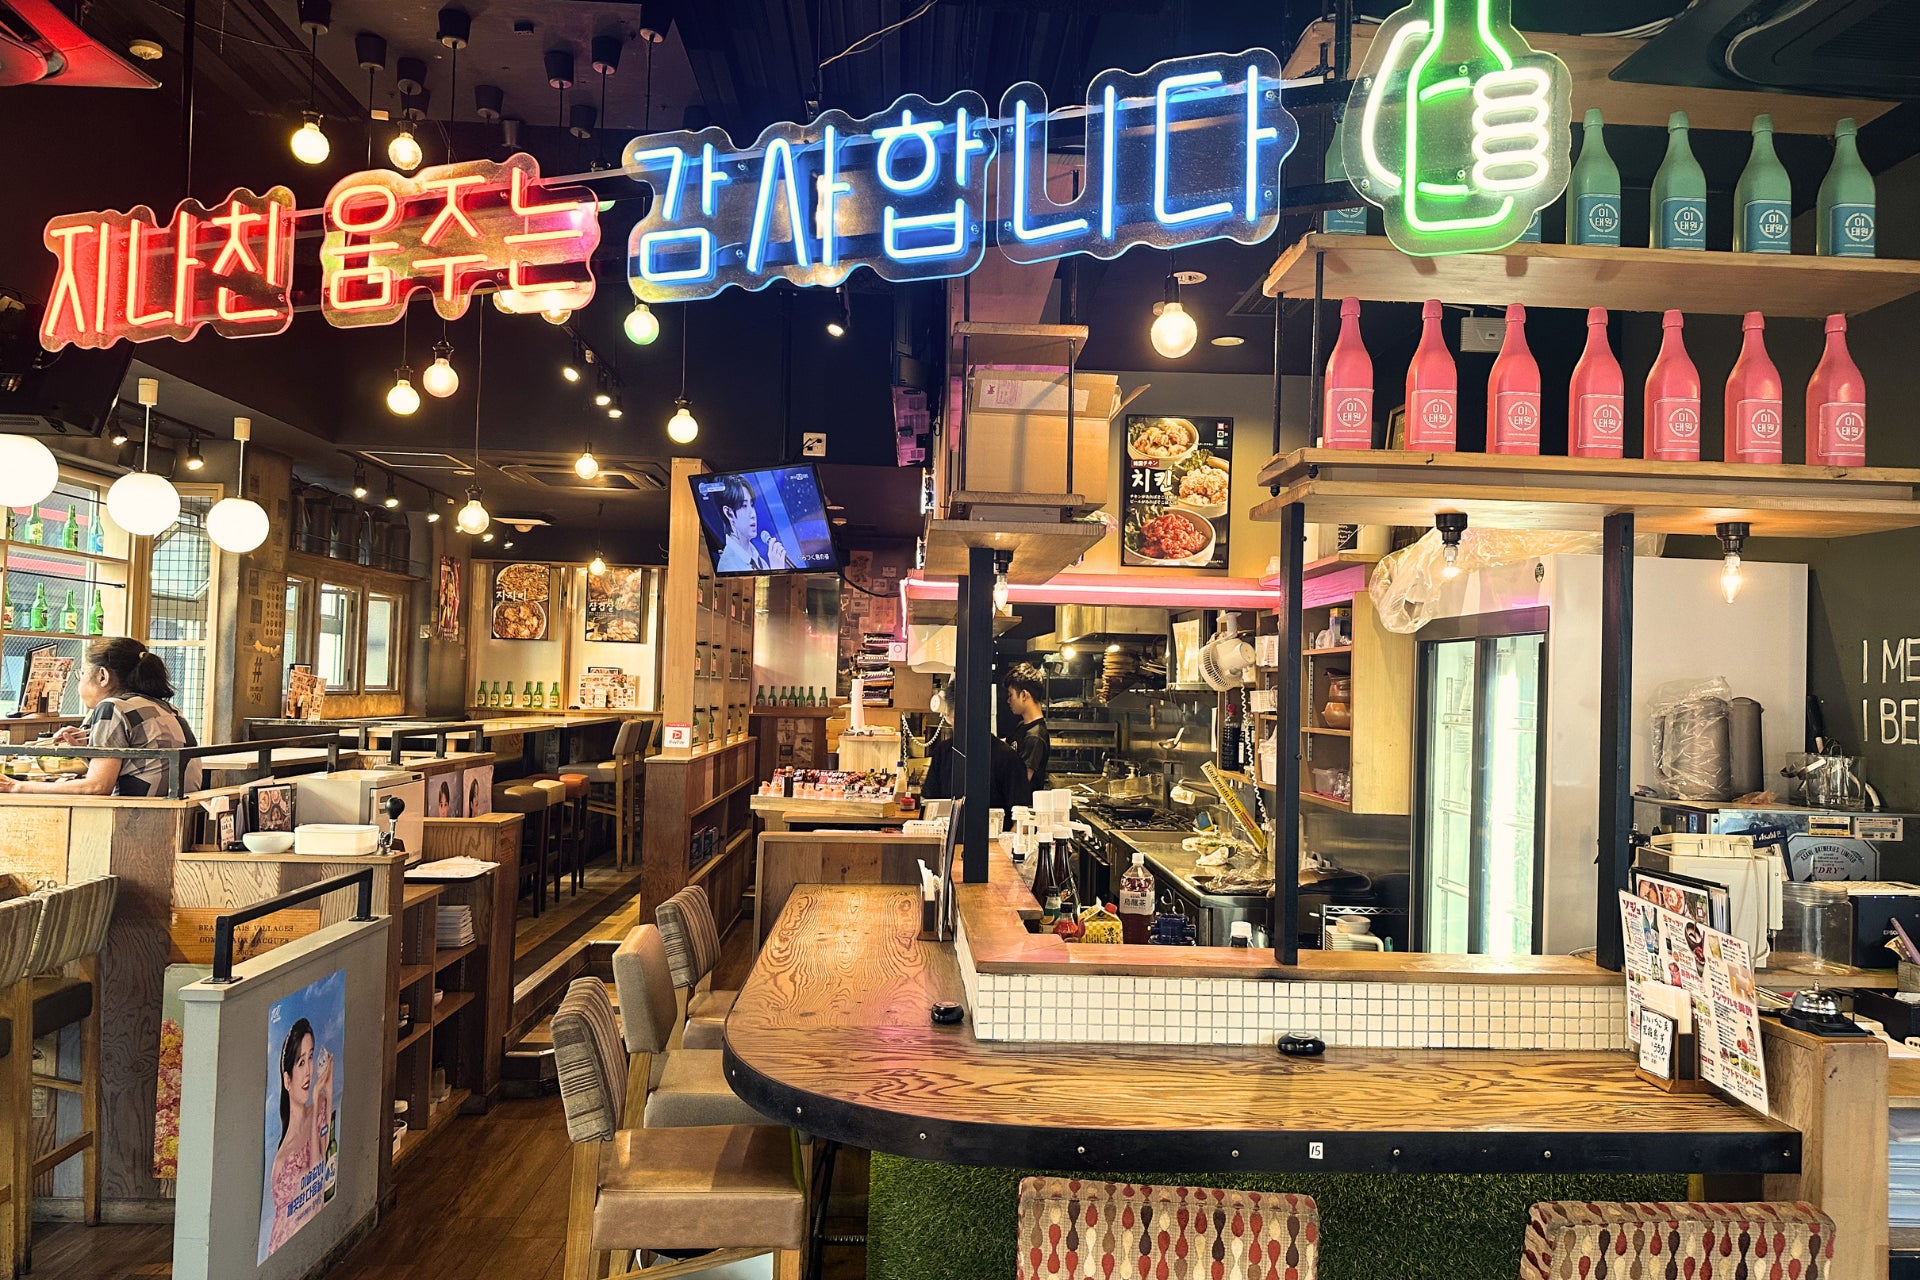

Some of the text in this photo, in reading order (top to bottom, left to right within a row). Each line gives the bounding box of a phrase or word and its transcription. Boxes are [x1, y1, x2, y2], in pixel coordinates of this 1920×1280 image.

[45, 65, 1277, 336] 지나친 음주는 감사합니다
[1599, 208, 1608, 217] 이
[1683, 211, 1693, 221] 이
[1595, 217, 1612, 227] 태원
[1769, 214, 1779, 223] 이
[1854, 217, 1865, 227] 이
[1680, 221, 1698, 231] 태원
[1765, 224, 1783, 234] 태원
[1851, 227, 1869, 237] 태원
[1346, 402, 1357, 412] 이
[1432, 403, 1443, 413] 이
[1517, 406, 1528, 416] 이
[1343, 412, 1361, 422] 태원
[1428, 414, 1447, 423] 태원
[1602, 409, 1612, 418] 이
[1678, 413, 1689, 422] 이
[1760, 413, 1771, 423] 이
[1514, 416, 1532, 426] 태원
[1598, 418, 1616, 429] 태원
[1845, 417, 1855, 426] 이
[1675, 422, 1693, 432] 태원
[1757, 424, 1775, 433] 태원
[1841, 426, 1859, 436] 태원
[1131, 468, 1173, 493] 치킨
[1879, 697, 1920, 745] BE
[1229, 796, 1242, 814] Wrap
[1758, 830, 1777, 841] Asahi
[1311, 1145, 1321, 1156] 15
